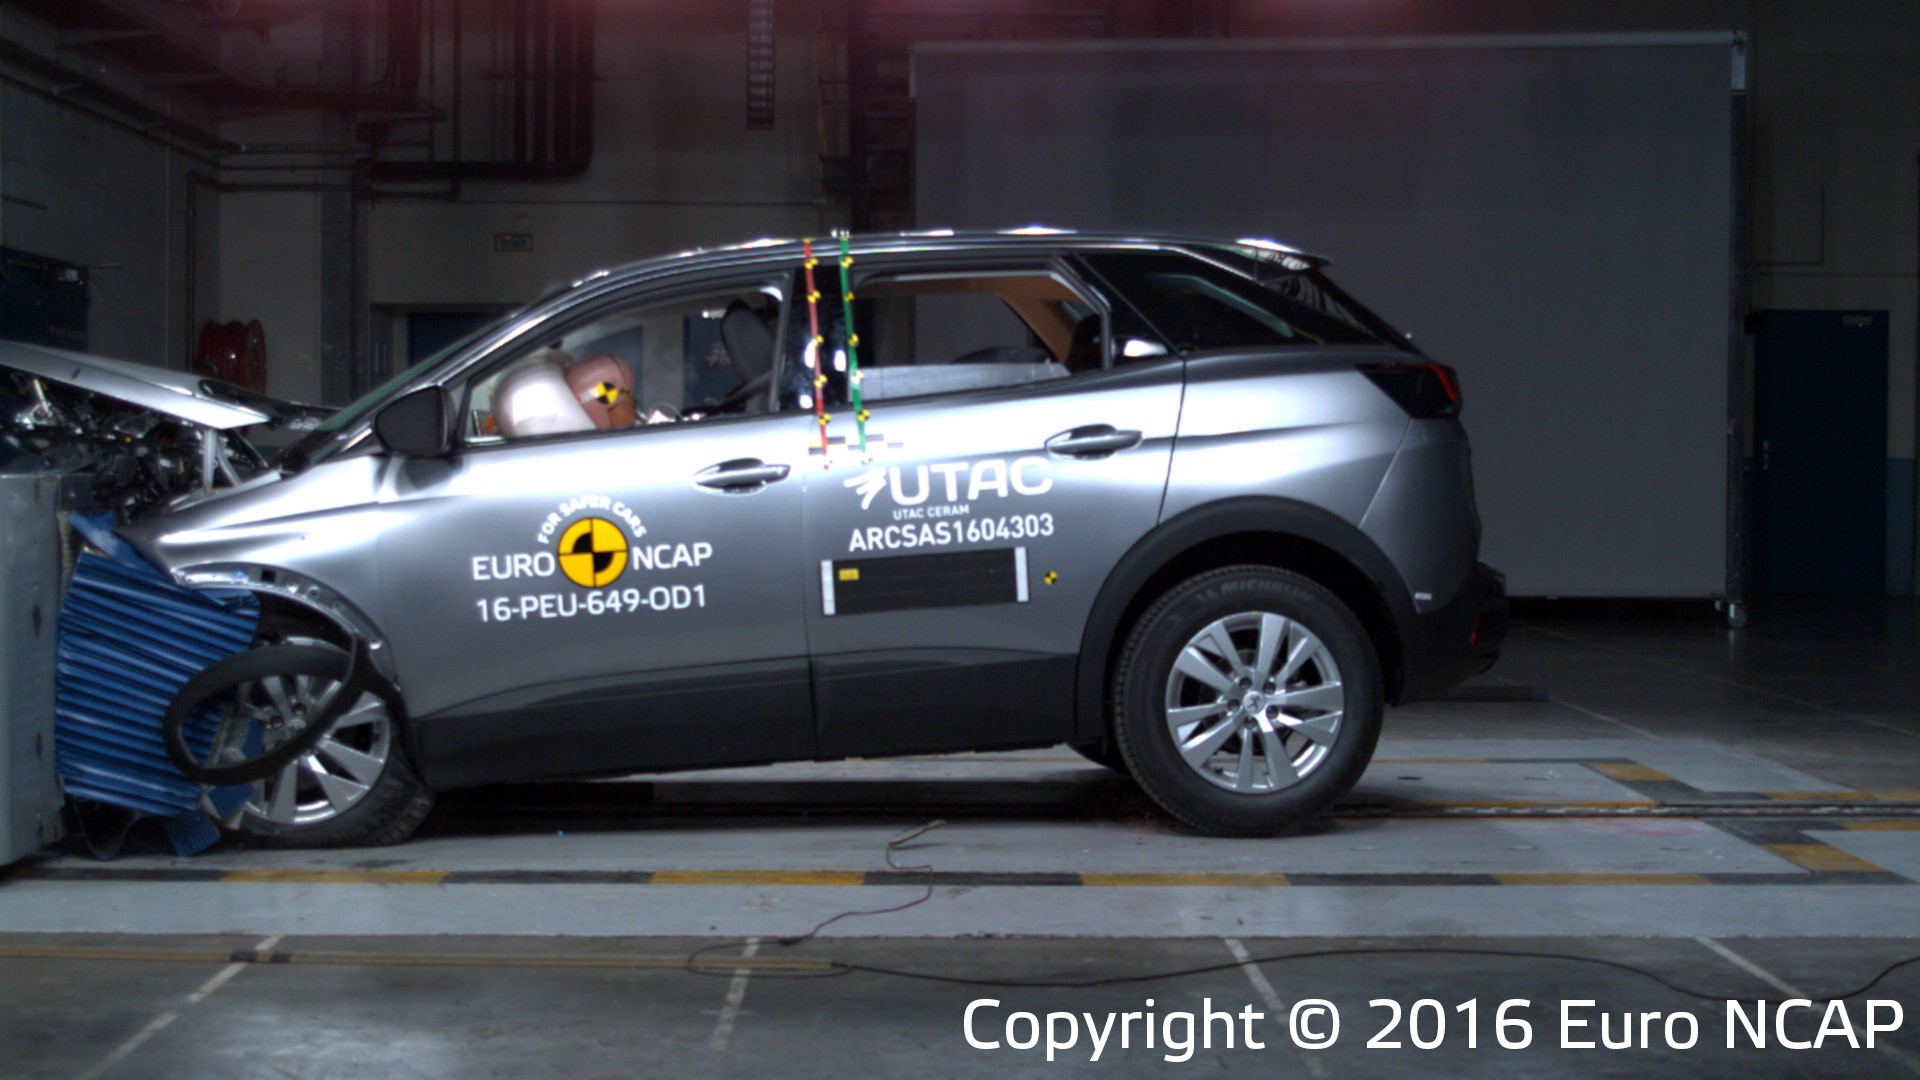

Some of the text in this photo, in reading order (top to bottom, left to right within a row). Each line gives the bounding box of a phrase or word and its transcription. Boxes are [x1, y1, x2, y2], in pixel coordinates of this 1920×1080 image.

[889, 456, 1054, 506] UTAC
[537, 495, 647, 545] FOR SAFER CARS
[893, 504, 970, 521] UTAC CERAM
[849, 513, 1055, 552] ARCSAS1604303
[472, 542, 713, 580] EURO NCAP
[476, 584, 706, 623] 16-PEU-649-OD1
